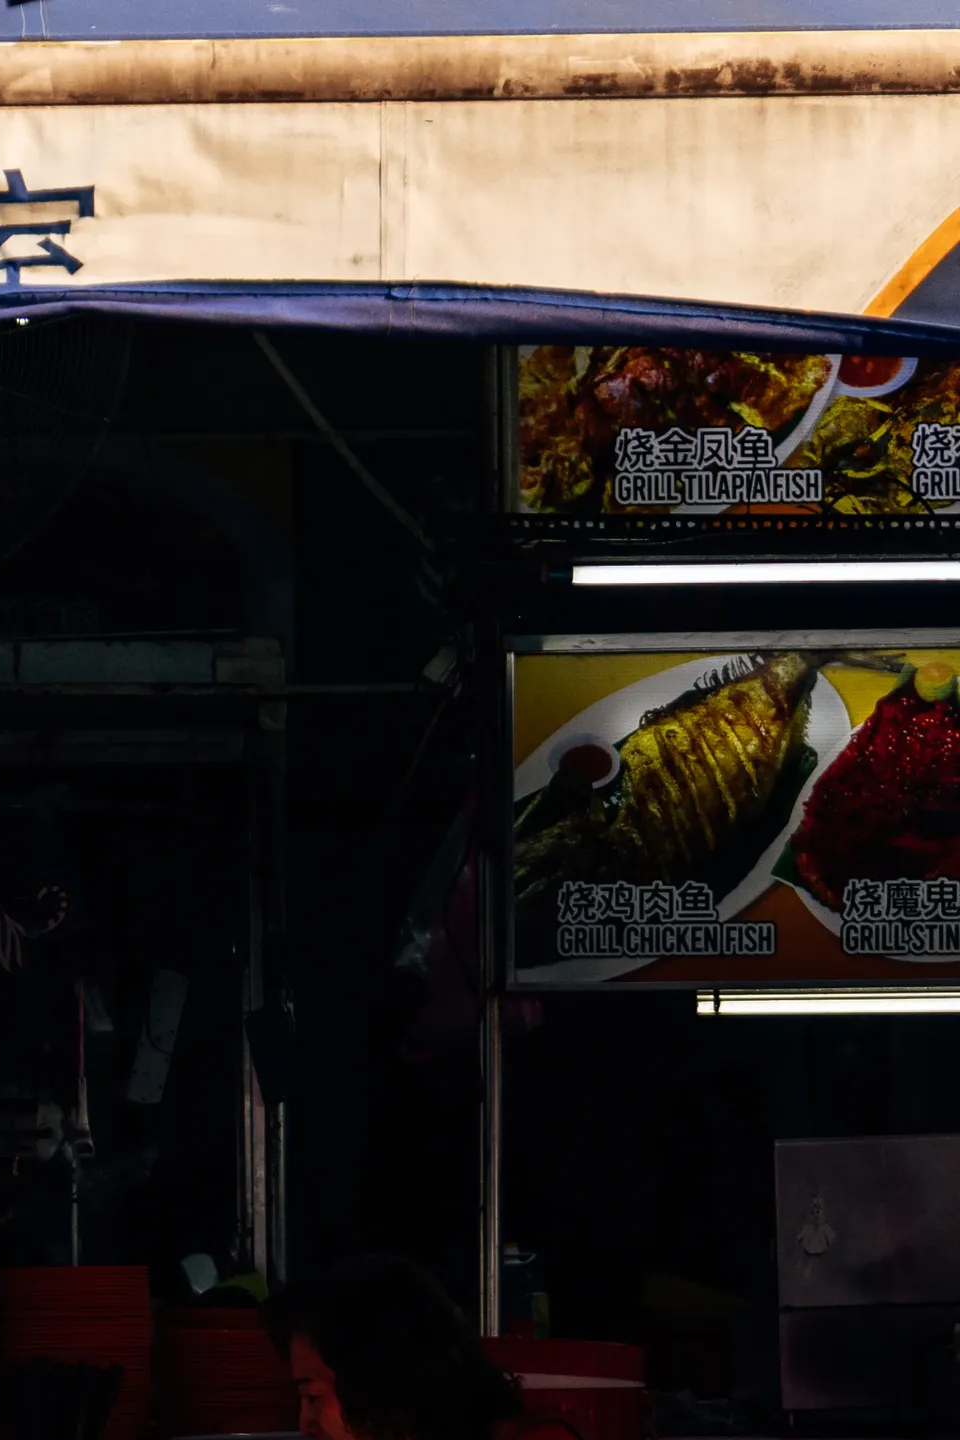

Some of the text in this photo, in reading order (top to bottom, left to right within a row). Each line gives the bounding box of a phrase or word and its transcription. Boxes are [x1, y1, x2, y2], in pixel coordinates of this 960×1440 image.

[616, 427, 777, 471] 烧金凤鱼
[913, 424, 960, 467] 烧
[616, 470, 822, 503] GRILL TILAPIA FISH
[558, 881, 717, 922] 烧鸡肉鱼
[558, 923, 774, 956] GRILL CHICKEN FISH
[843, 921, 909, 954] GRILL
